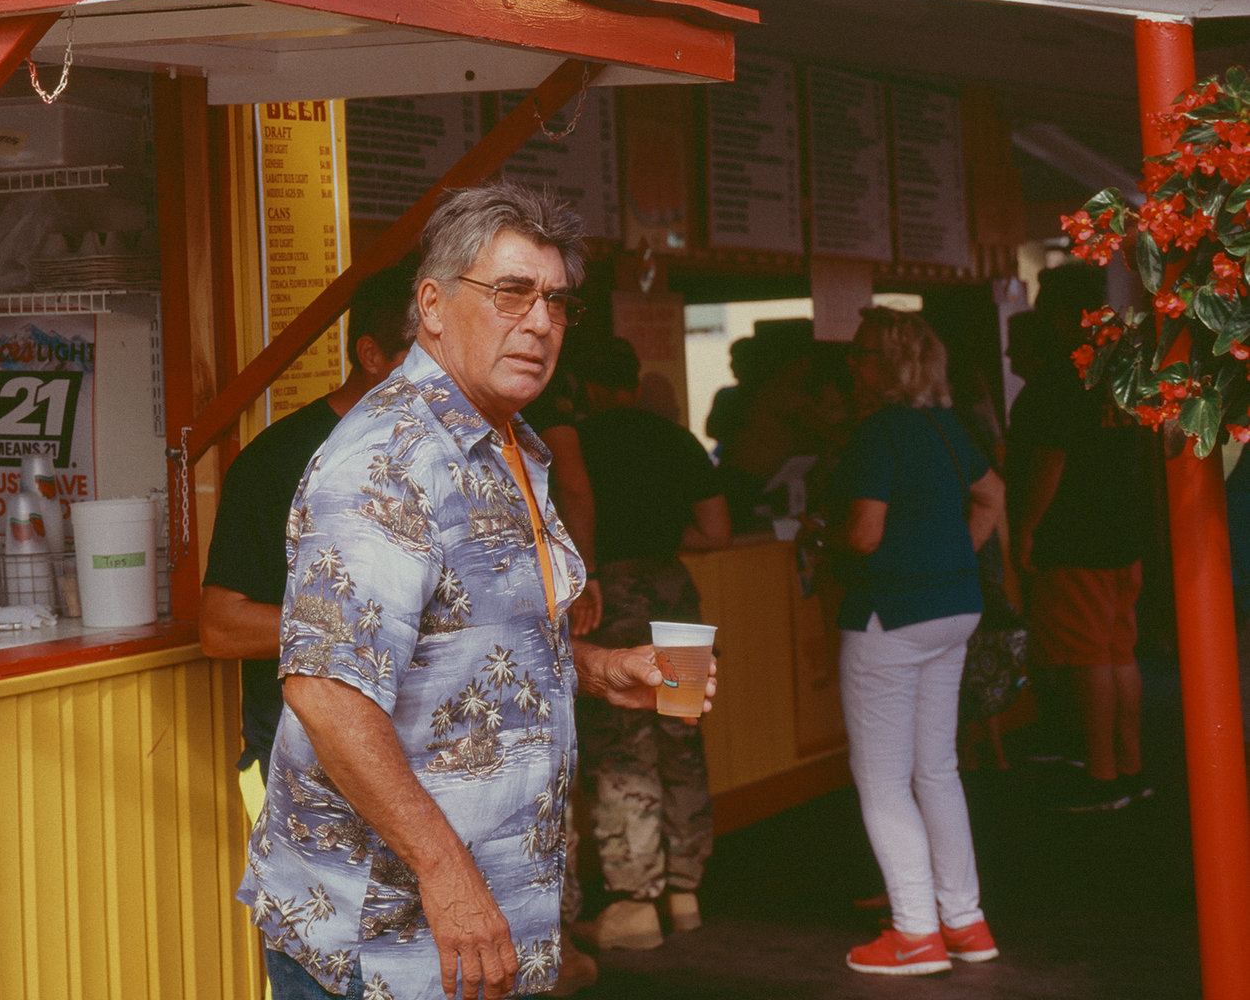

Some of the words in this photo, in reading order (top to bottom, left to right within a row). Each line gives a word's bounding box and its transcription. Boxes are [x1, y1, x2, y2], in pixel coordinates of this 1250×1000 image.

[265, 126, 292, 138] DRAFT
[268, 208, 290, 219] CANS
[37, 342, 95, 363] LIGHT
